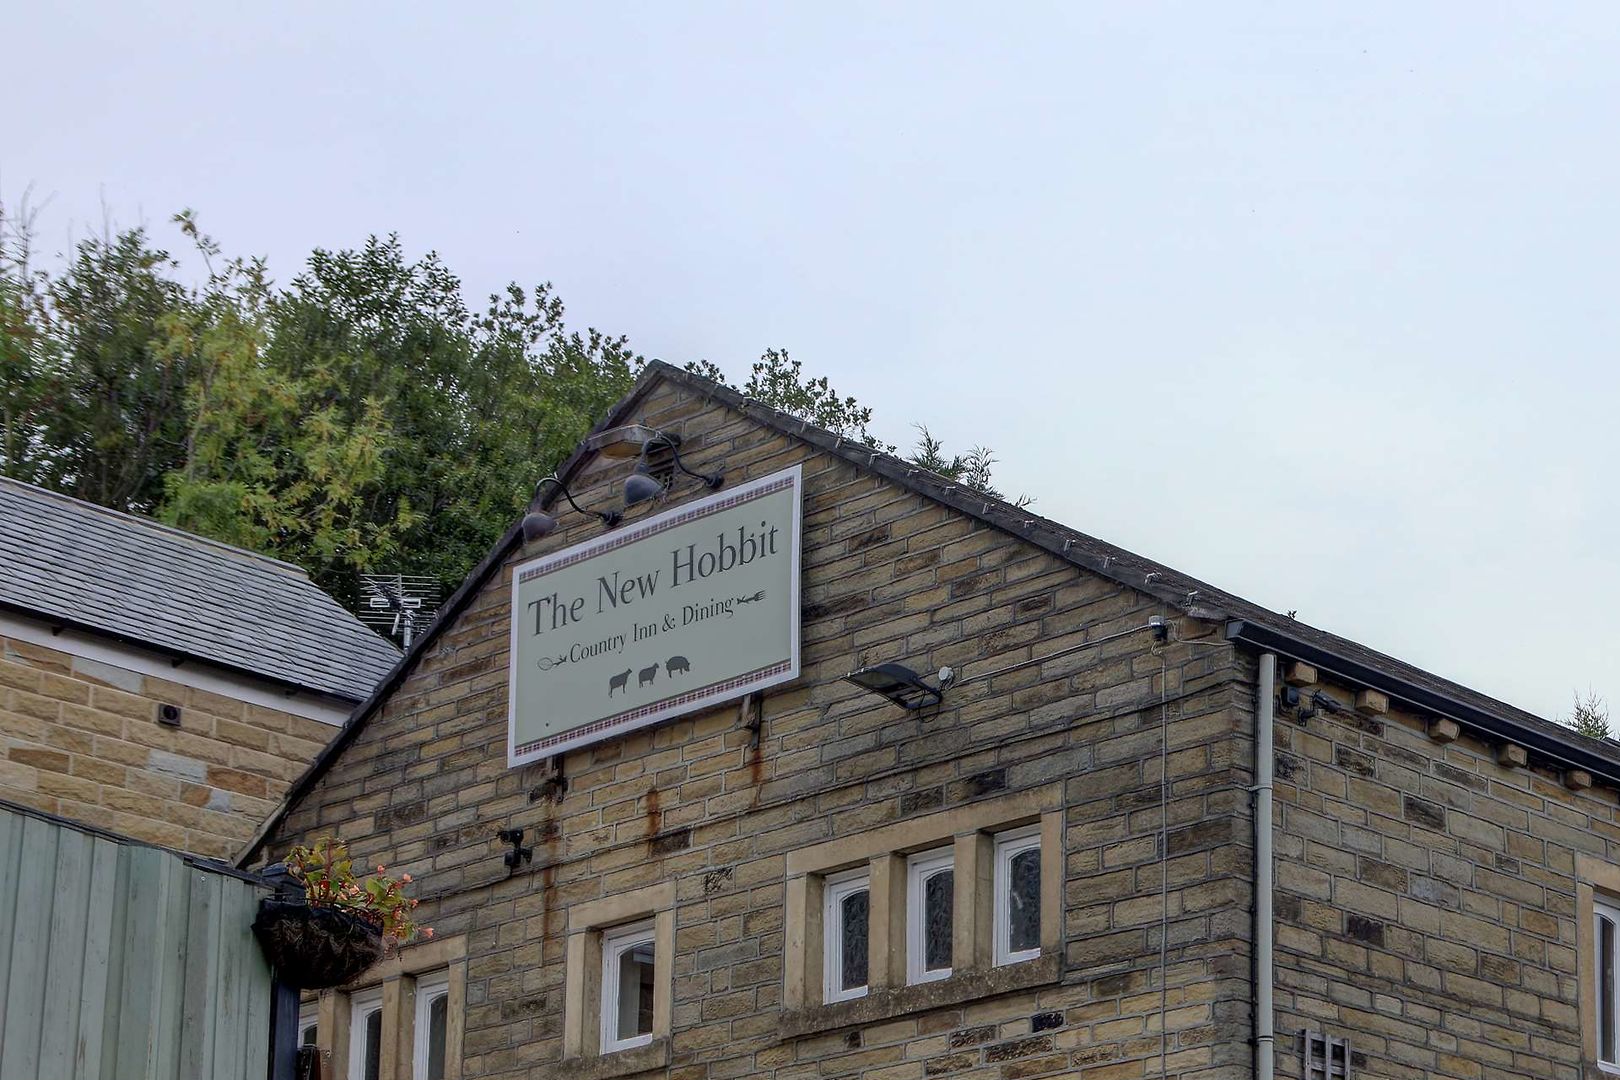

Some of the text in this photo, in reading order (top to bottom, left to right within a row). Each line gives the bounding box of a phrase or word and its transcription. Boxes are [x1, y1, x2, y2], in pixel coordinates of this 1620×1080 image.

[528, 520, 778, 637] The New Hobbit
[569, 598, 735, 662] Country Inn & Dining
